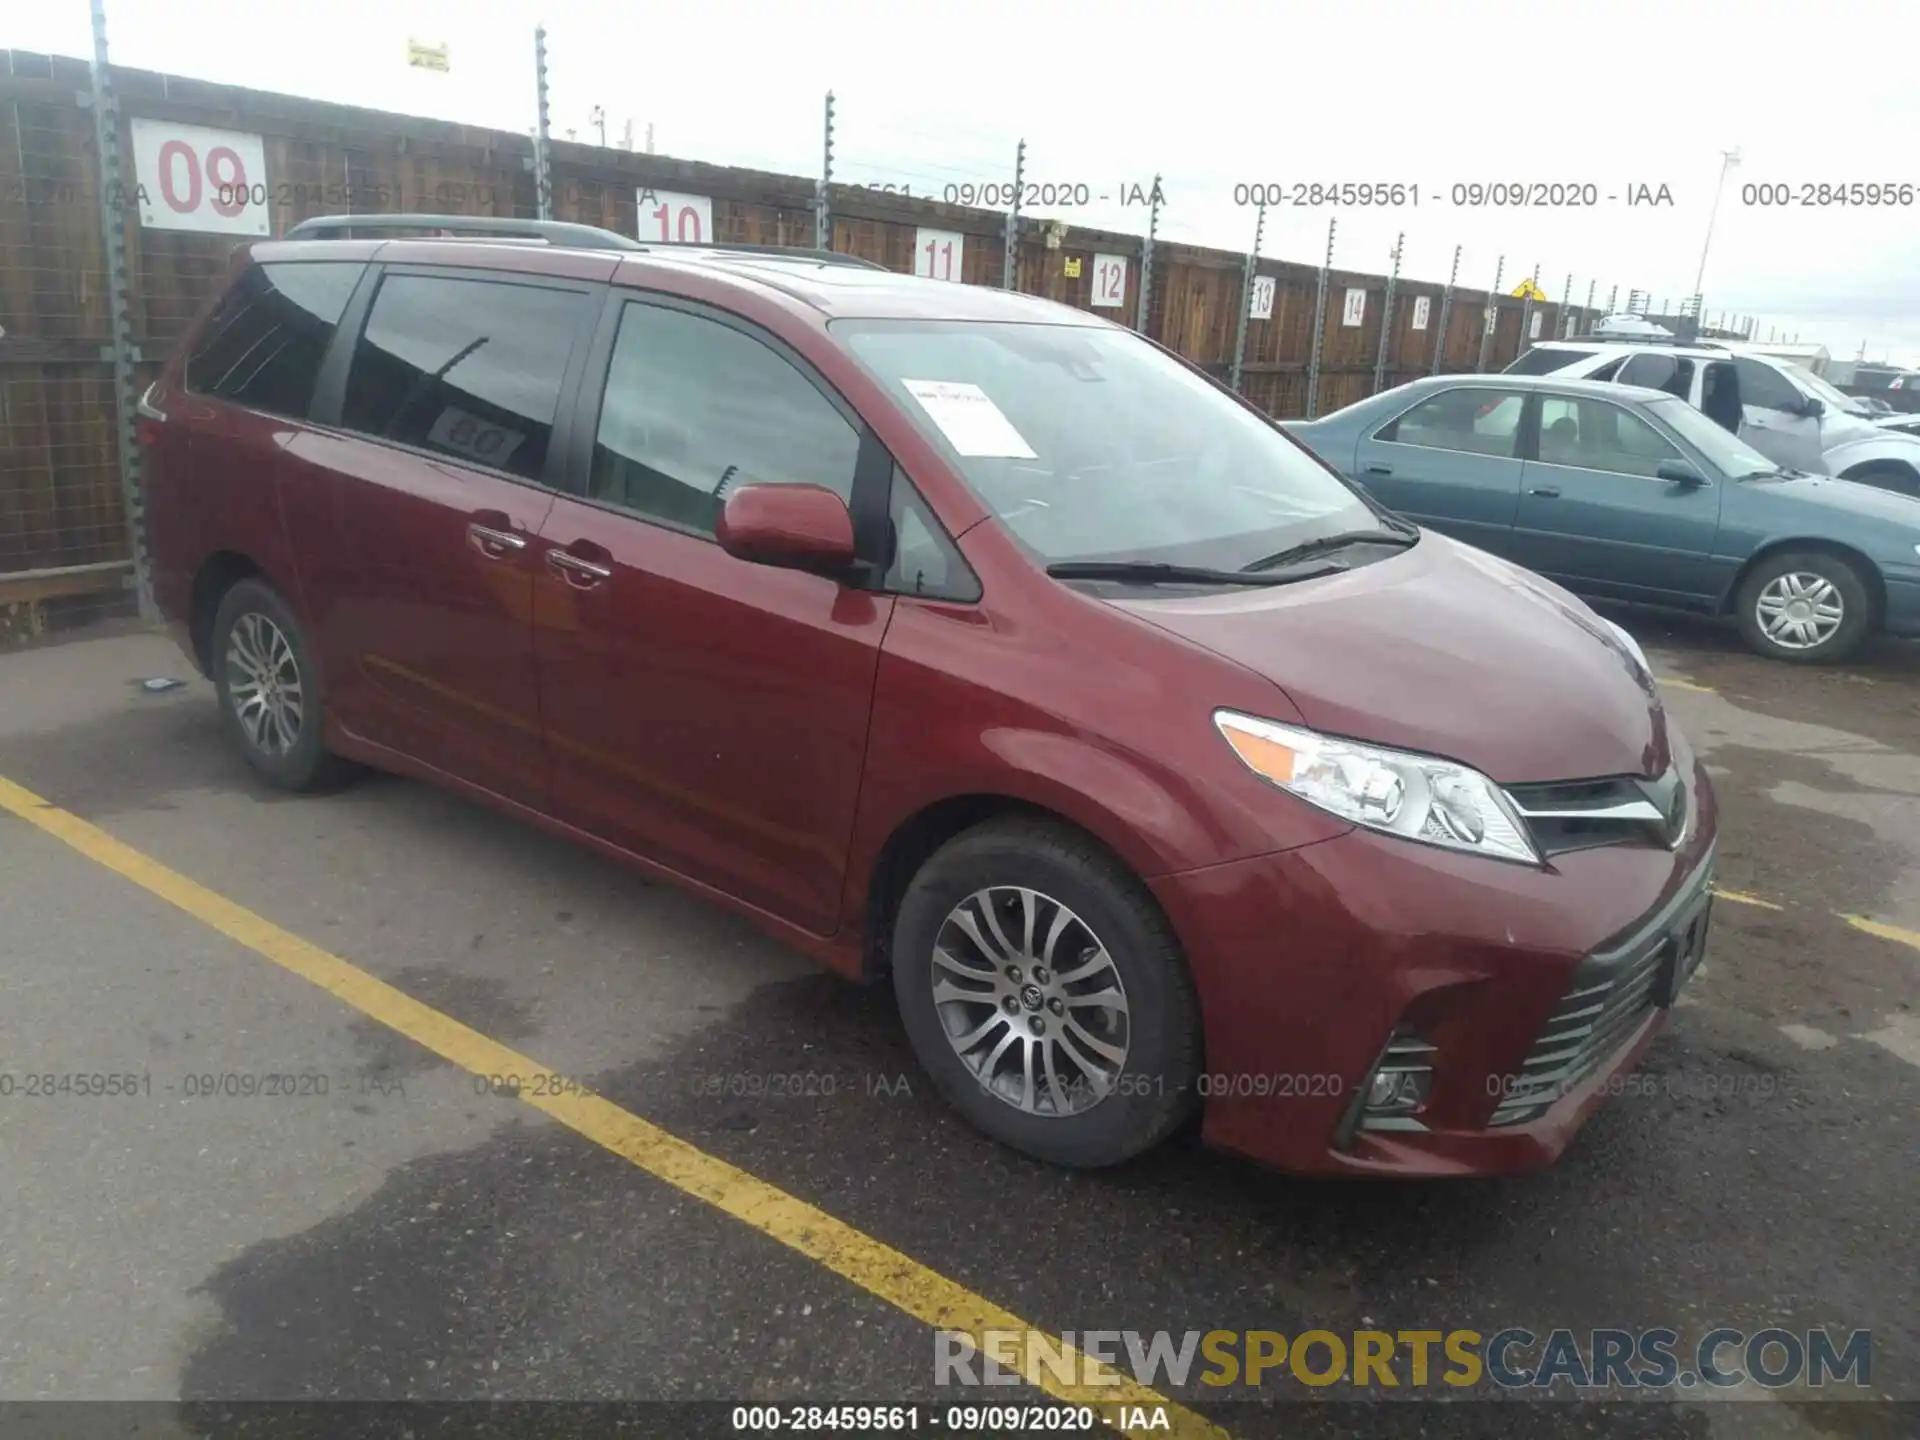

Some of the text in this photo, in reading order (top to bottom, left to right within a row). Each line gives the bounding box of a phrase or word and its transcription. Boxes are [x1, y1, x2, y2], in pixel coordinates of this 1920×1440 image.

[158, 140, 248, 217] 09
[650, 202, 702, 243] 10
[924, 237, 953, 280] 11
[1099, 260, 1121, 298] 12
[1256, 281, 1271, 312] 13
